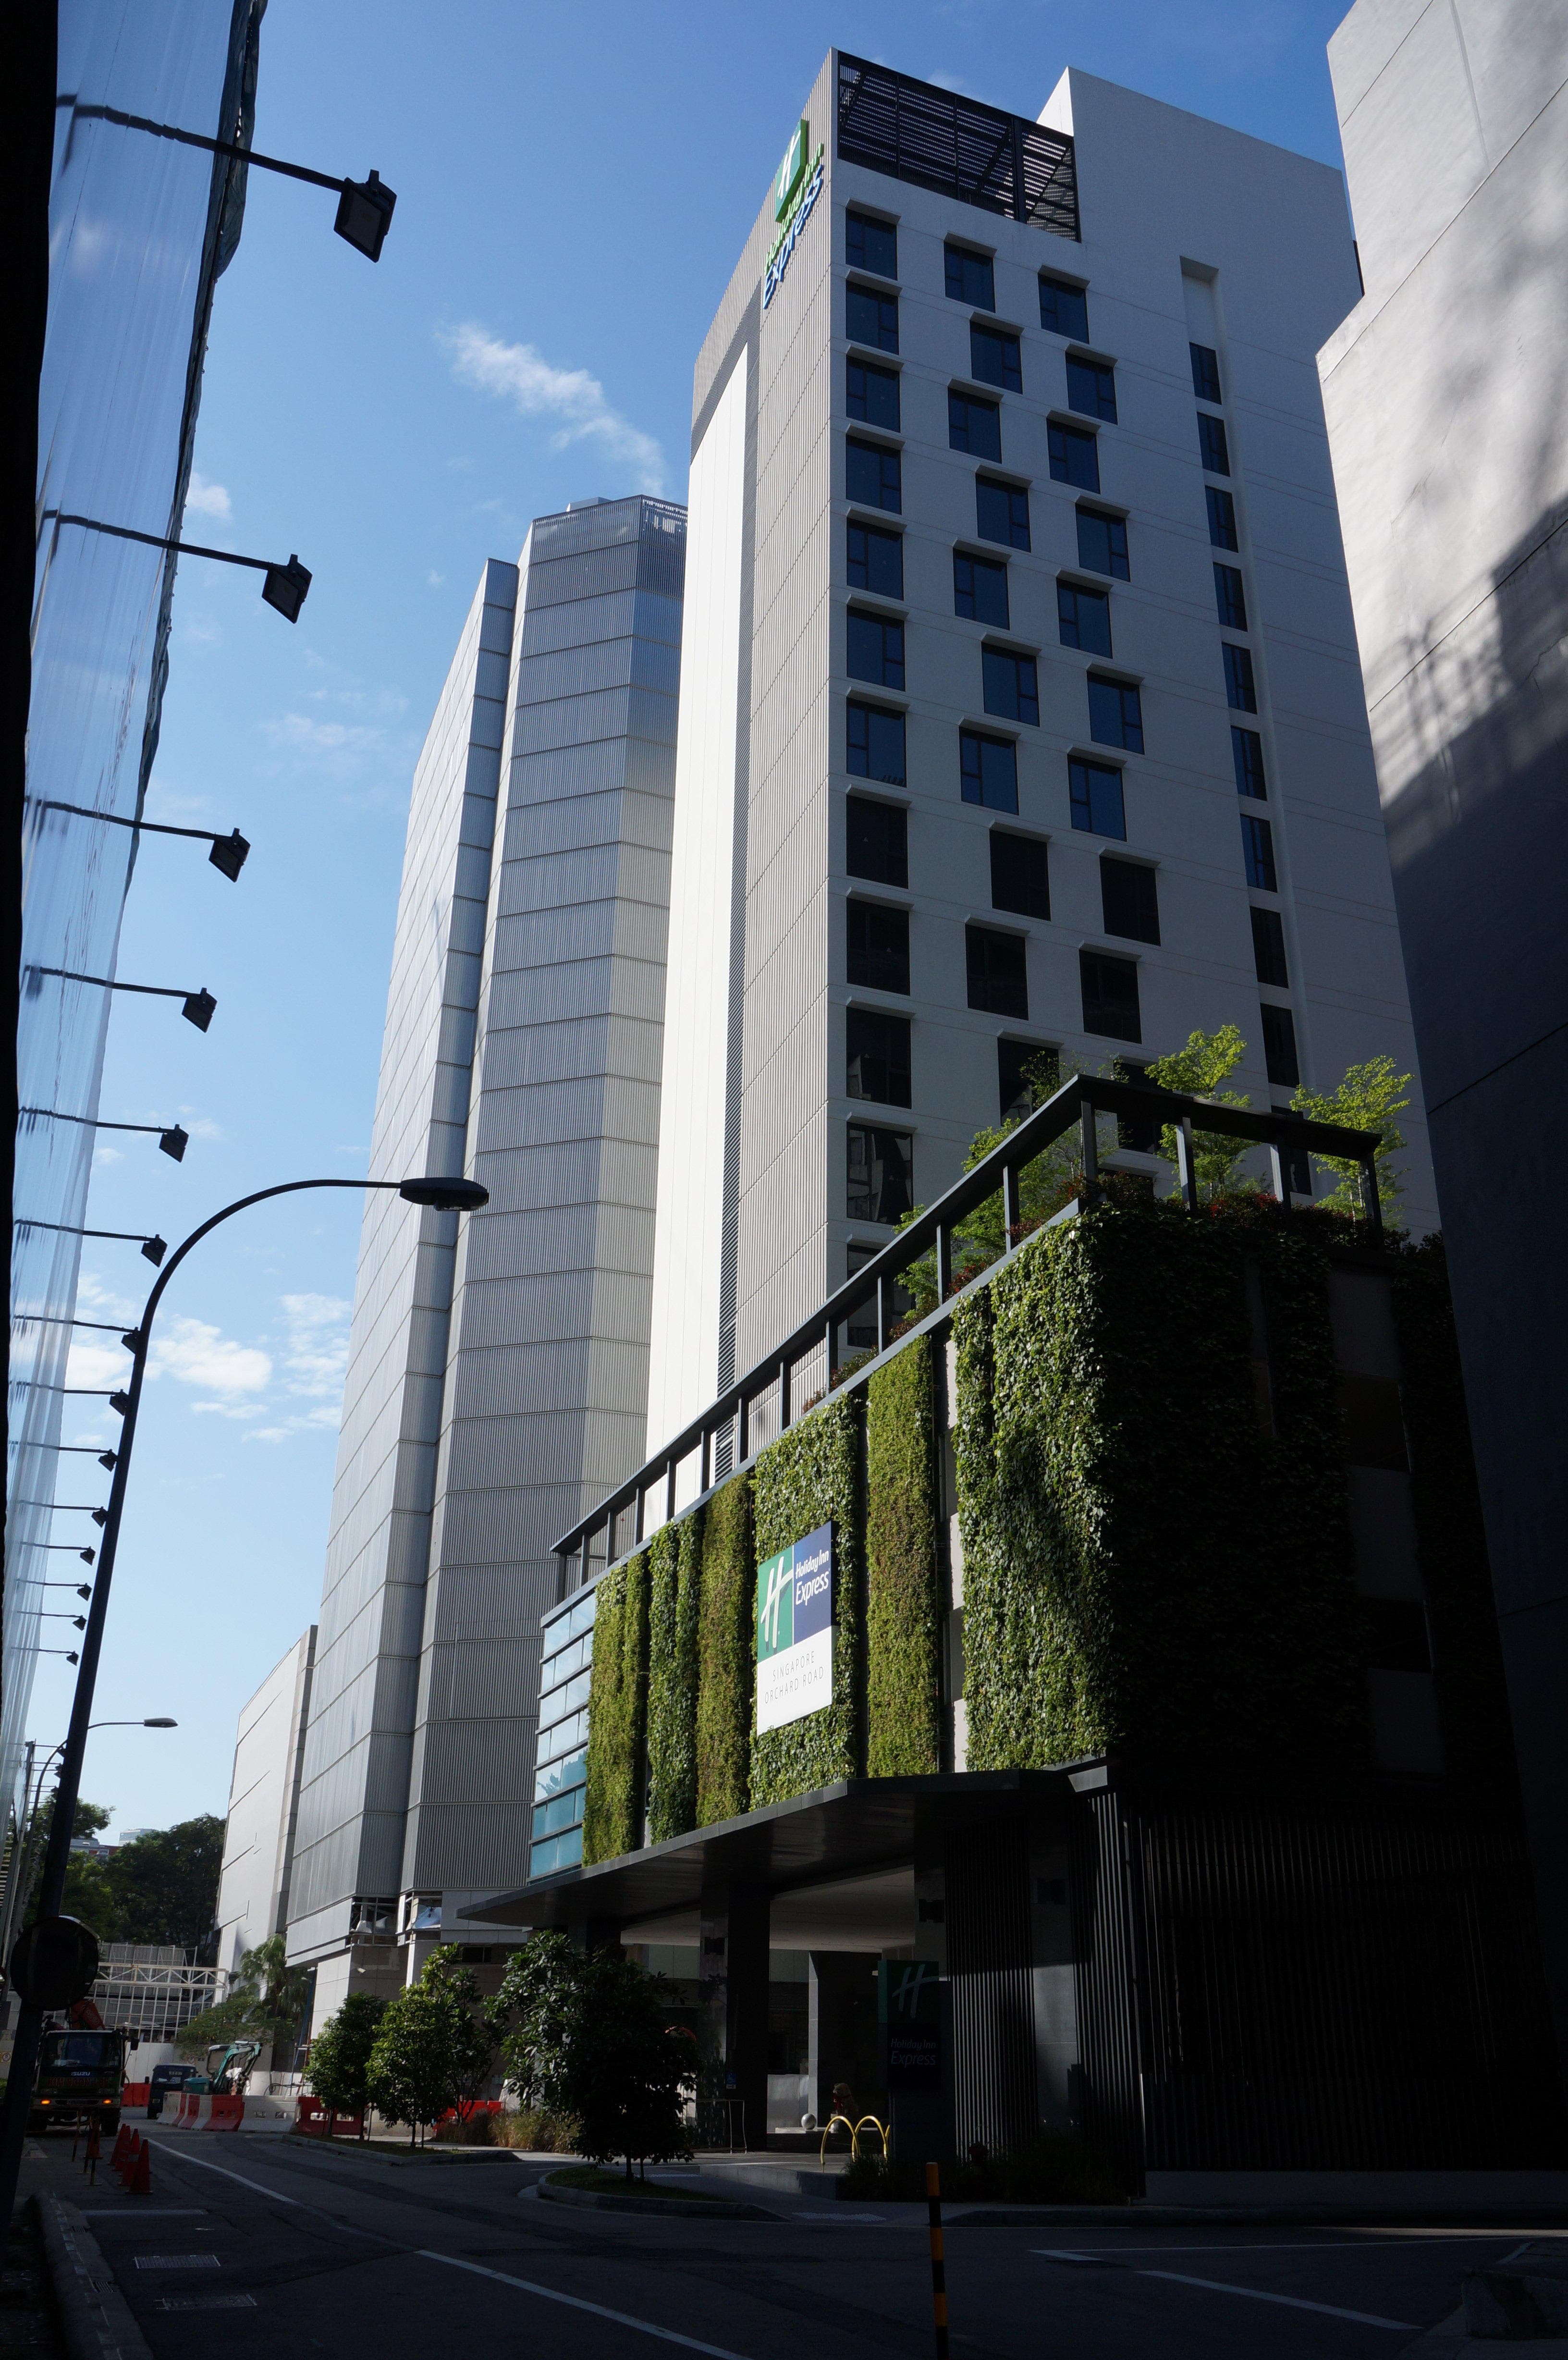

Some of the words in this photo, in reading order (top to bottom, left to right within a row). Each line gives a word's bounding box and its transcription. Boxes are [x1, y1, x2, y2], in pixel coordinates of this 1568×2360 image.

[764, 179, 805, 276] Holiday
[804, 143, 824, 187] Inn
[763, 164, 824, 310] Express
[796, 1556, 819, 1579] Holiday
[819, 1549, 829, 1565] Inn
[796, 1571, 829, 1606] Express
[773, 1651, 814, 1682] SINGAPORE
[765, 1678, 799, 1704] ORCHARD
[803, 1666, 823, 1687] ROAD
[891, 2038, 922, 2051] Holiday
[922, 2038, 936, 2049] Inn
[891, 2051, 936, 2068] Express
